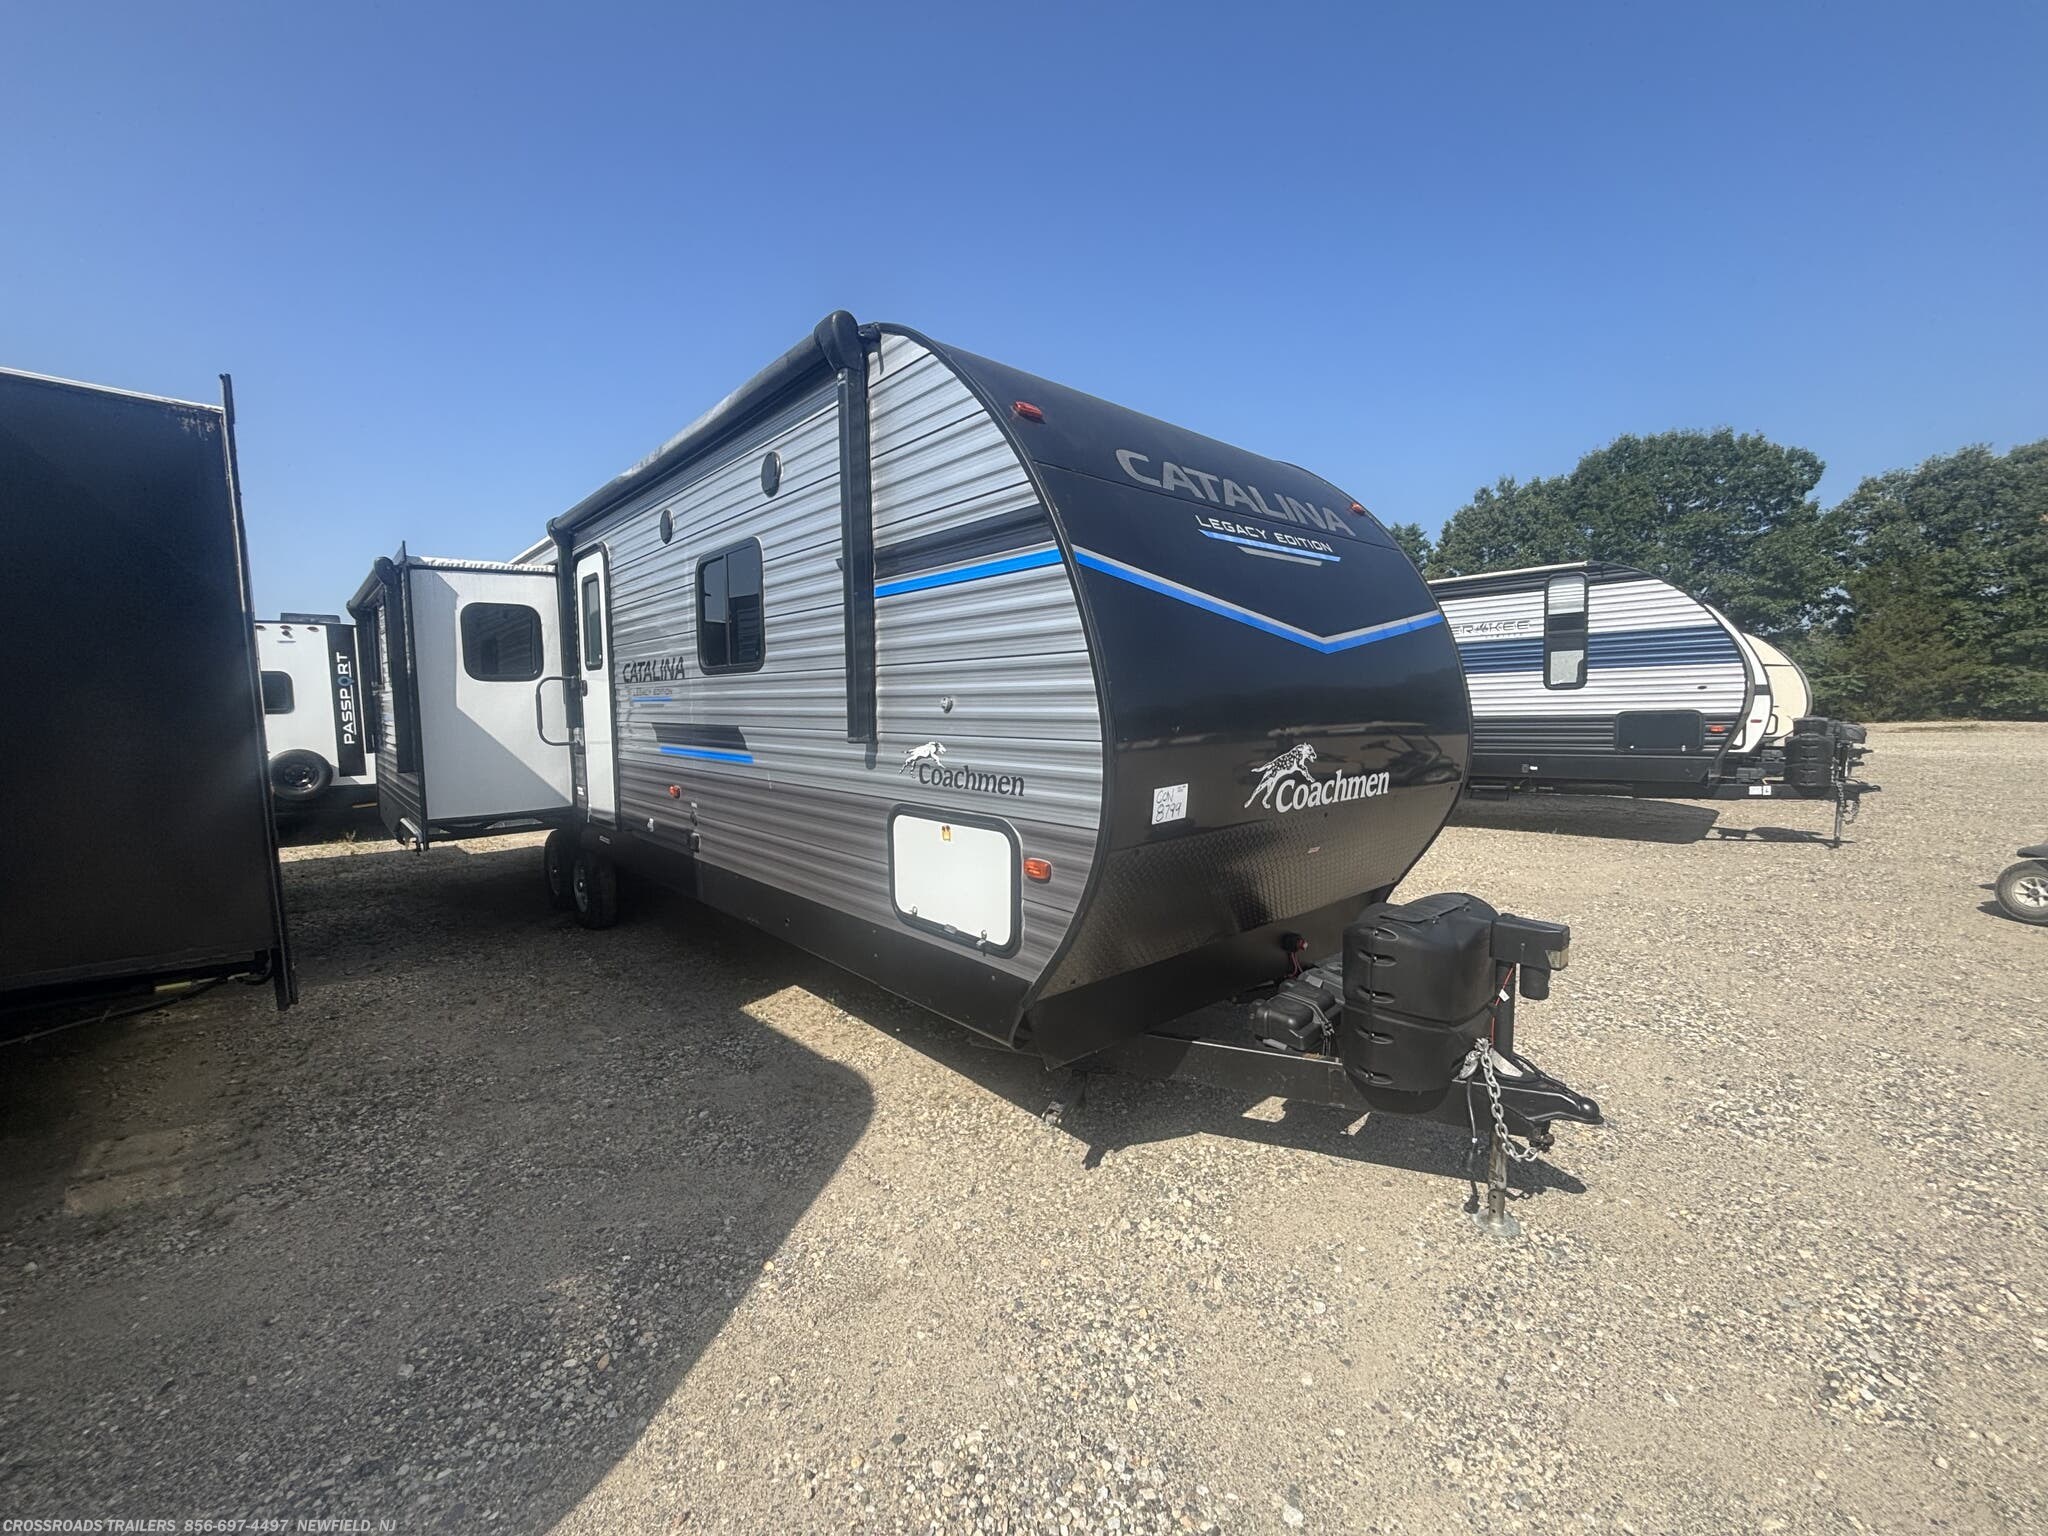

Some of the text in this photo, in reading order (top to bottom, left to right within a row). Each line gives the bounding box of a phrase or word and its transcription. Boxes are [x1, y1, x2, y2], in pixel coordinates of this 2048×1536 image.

[1115, 449, 1356, 537] CATALINA
[1195, 515, 1333, 552] LEGACY EDITION
[622, 656, 685, 683] CATALINA
[336, 652, 356, 744] PASSPORT
[919, 763, 1024, 796] Coachmen
[1276, 769, 1390, 813] Coachmen
